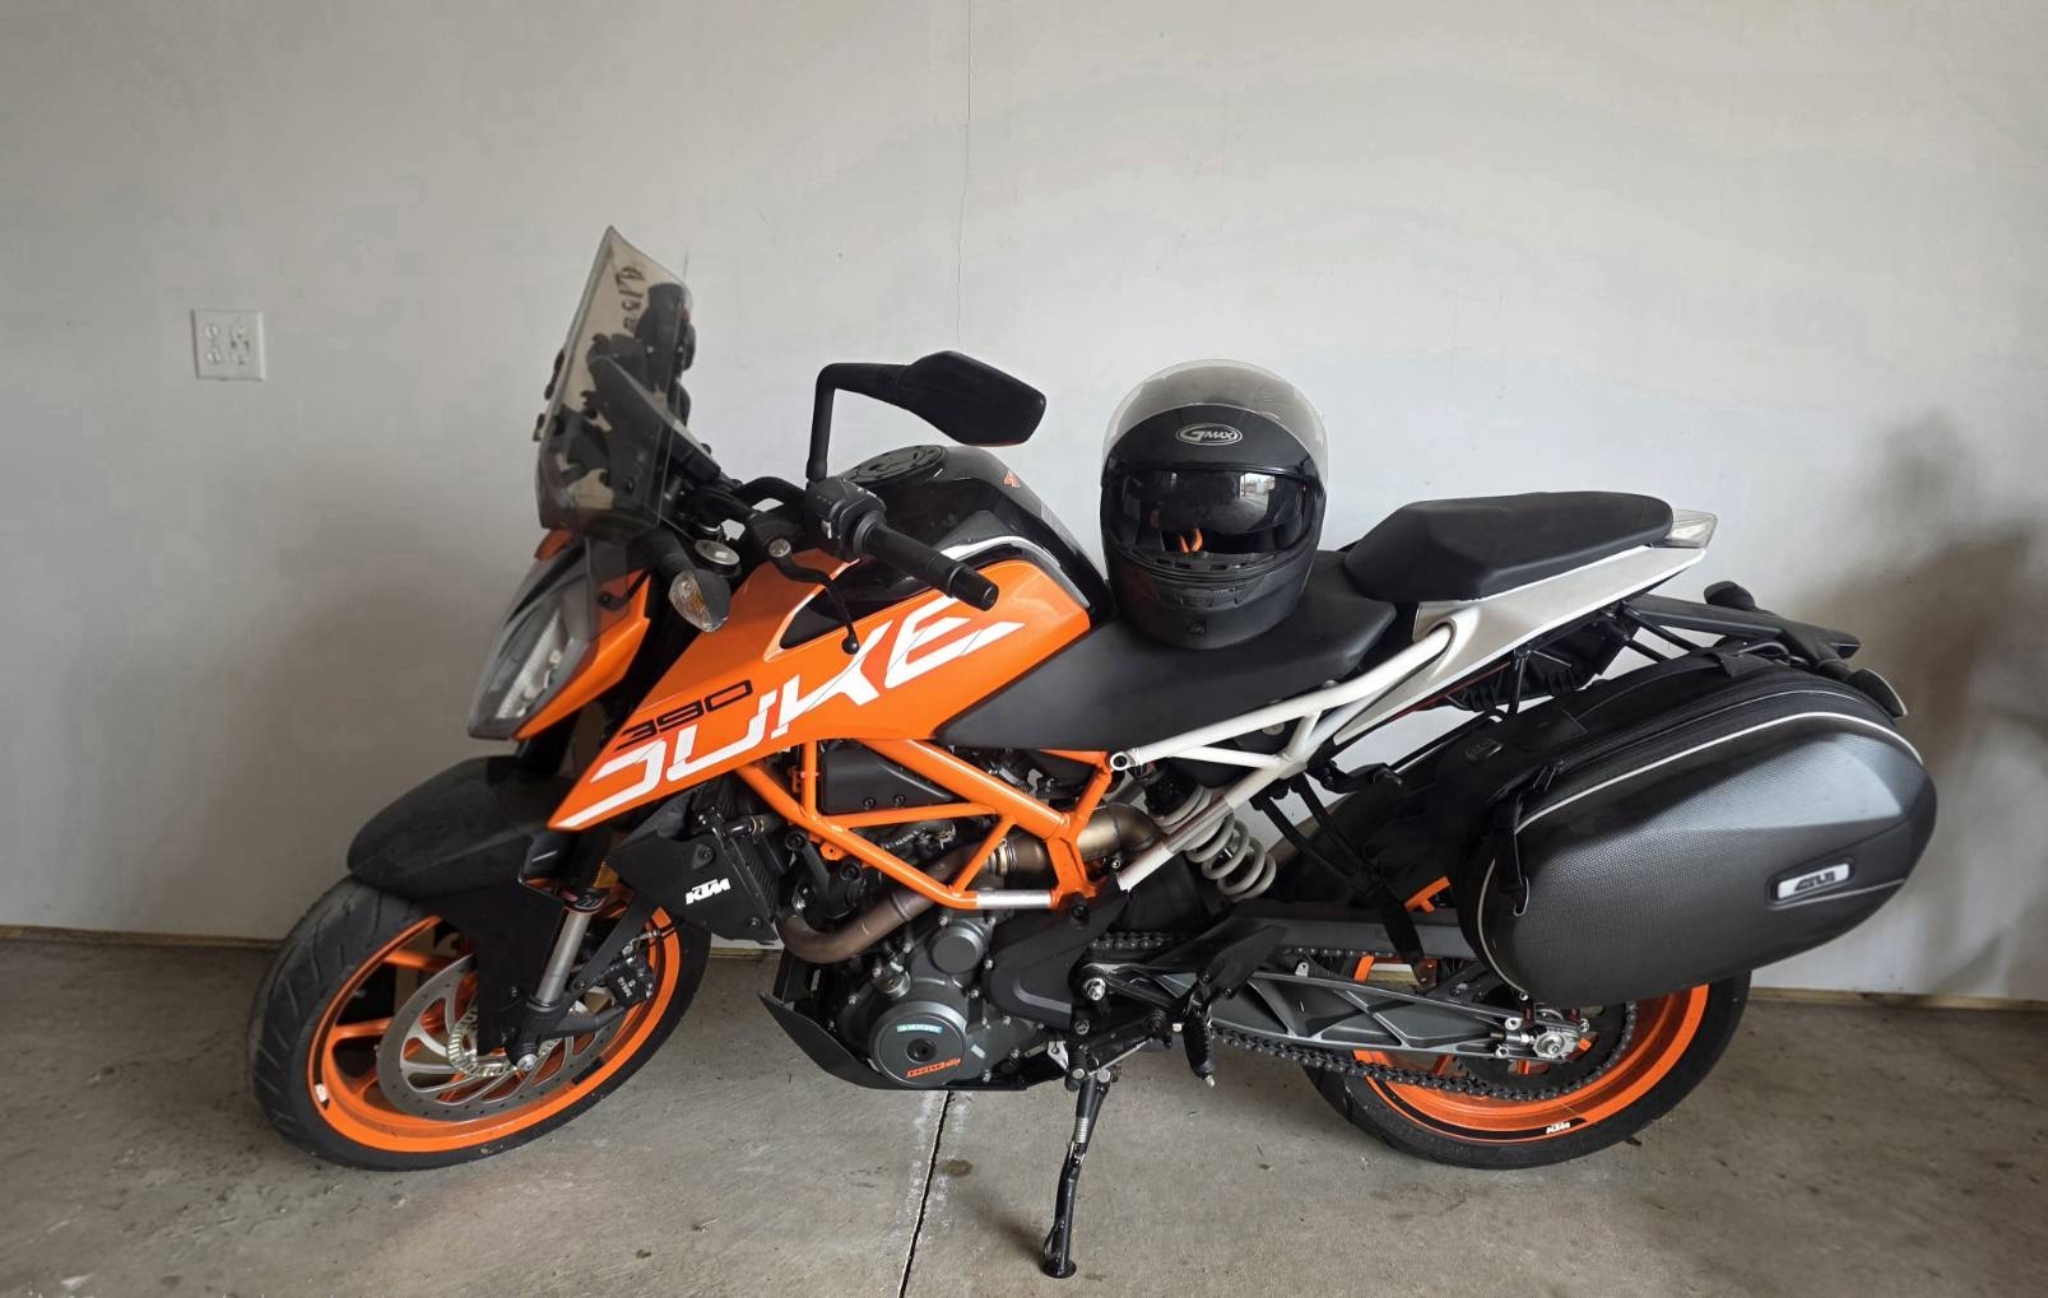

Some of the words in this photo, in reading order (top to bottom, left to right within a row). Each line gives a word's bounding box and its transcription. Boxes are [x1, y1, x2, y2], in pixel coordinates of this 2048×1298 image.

[1179, 426, 1241, 442] GMAX
[554, 595, 1027, 828] DUKE
[613, 680, 753, 751] 390
[685, 877, 731, 905] KTM
